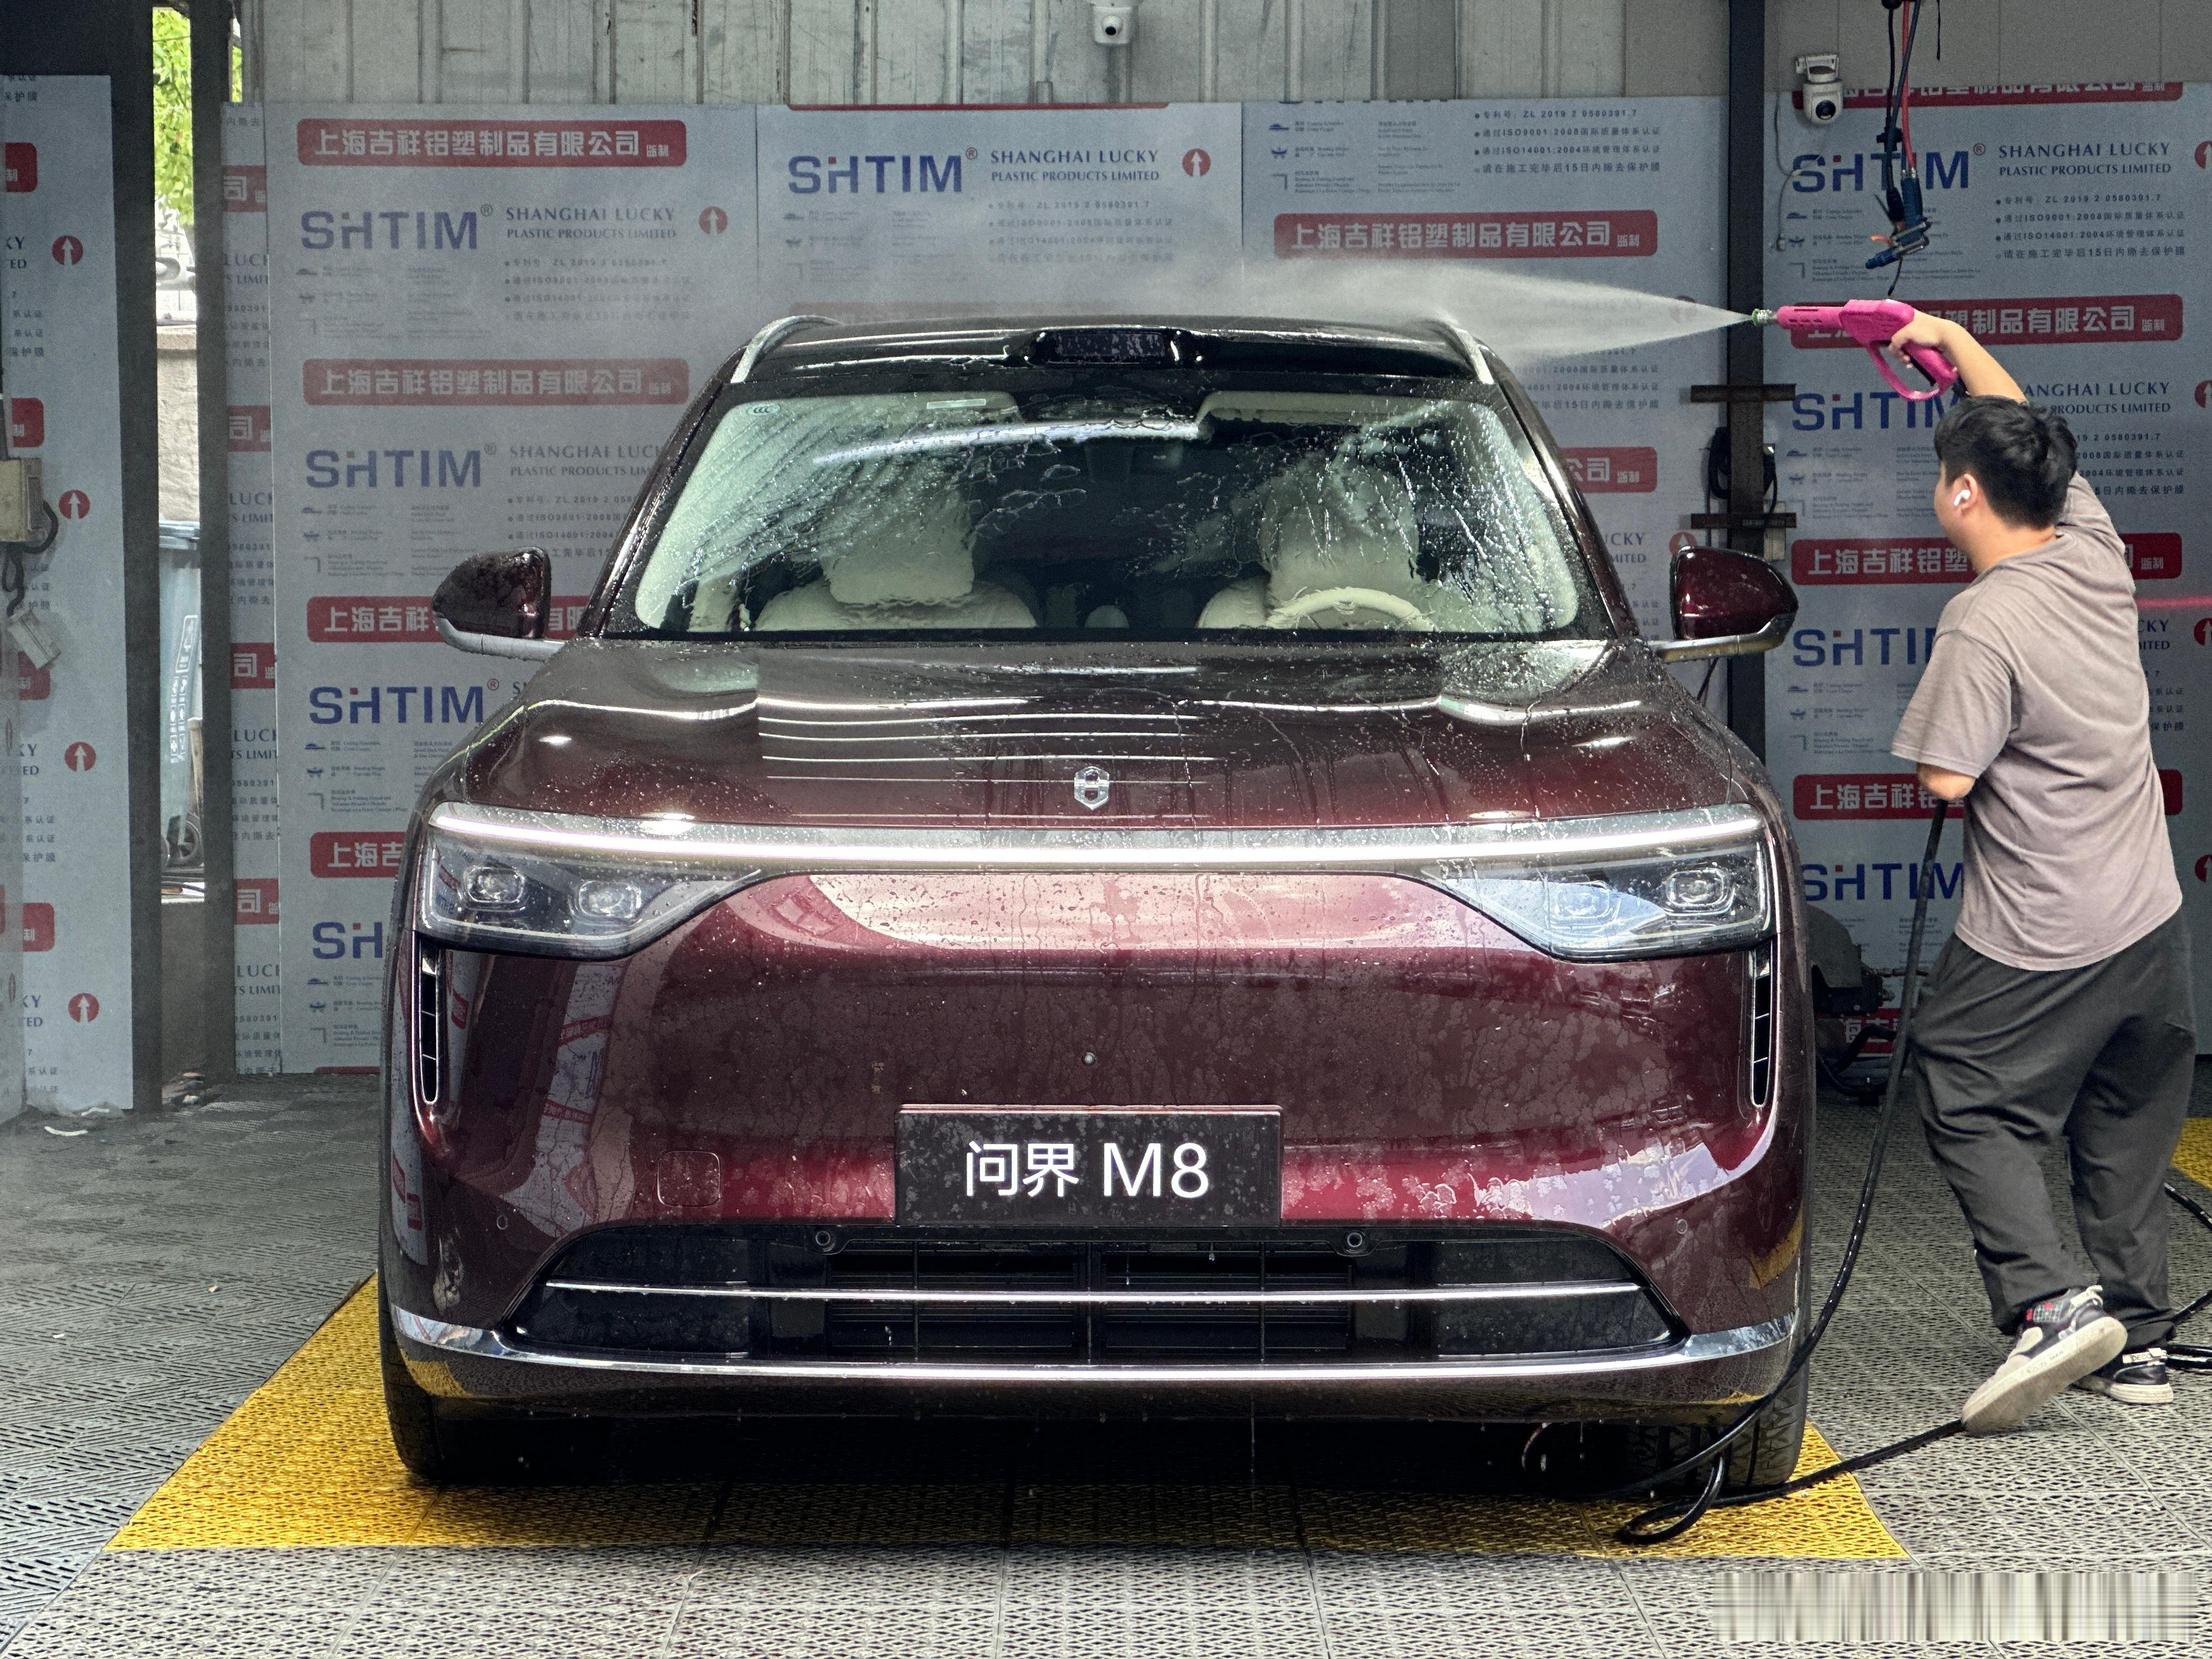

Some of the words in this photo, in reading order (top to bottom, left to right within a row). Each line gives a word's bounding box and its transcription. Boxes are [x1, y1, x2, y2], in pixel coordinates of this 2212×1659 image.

[314, 129, 640, 156] 上海吉祥铝塑制品有限公司
[990, 149, 1090, 164] SHANGHAI
[1099, 149, 1158, 163] LUCKY
[1999, 143, 2101, 159] SHANGHAI
[2109, 142, 2171, 156] LUCKY
[991, 171, 1039, 182] PLASTIC
[1042, 171, 1108, 181] PRODUCTS
[1111, 171, 1160, 181] LIMITED
[1999, 166, 2046, 177] PLASTIC
[2051, 164, 2118, 176] PRODUCTS
[2121, 163, 2172, 174] LIMITED
[506, 207, 607, 221] SHANGHAI
[615, 207, 675, 221] LUCKY
[506, 228, 554, 239] PLASTIC
[558, 228, 624, 239] PRODUCTS
[628, 228, 676, 238] LIMITED
[1291, 221, 1610, 250] 上海吉祥铝塑制品有限公司
[320, 368, 642, 396] 上海吉祥铝塑制品有限公司
[2109, 381, 2170, 396] LUCKY
[2121, 402, 2170, 414] LIMITED
[510, 445, 609, 459] SHANGHAI
[510, 466, 554, 477] PLASTIC
[561, 466, 627, 476] PRODUCTS
[966, 1141, 1079, 1197] 问界
[1103, 1142, 1209, 1198] M8
